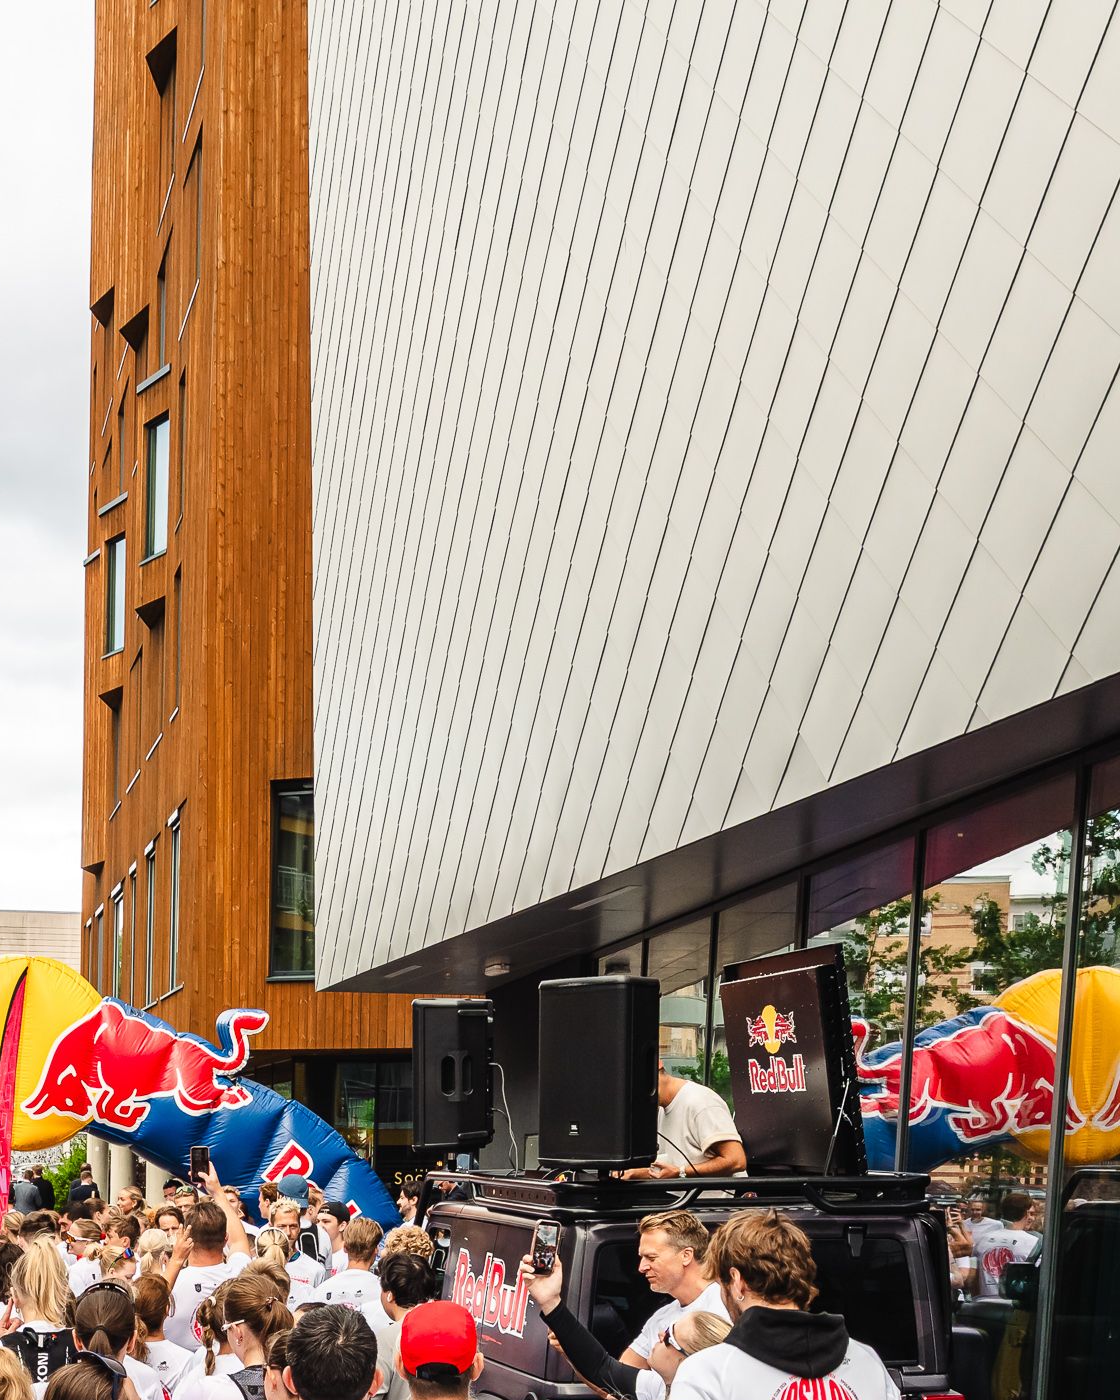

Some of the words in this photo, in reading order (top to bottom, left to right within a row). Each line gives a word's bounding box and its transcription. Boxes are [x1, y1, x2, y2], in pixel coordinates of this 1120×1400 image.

[748, 1056, 776, 1094] Red
[776, 1054, 807, 1093] Bull
[452, 1248, 493, 1323] Red
[484, 1257, 528, 1338] Bull
